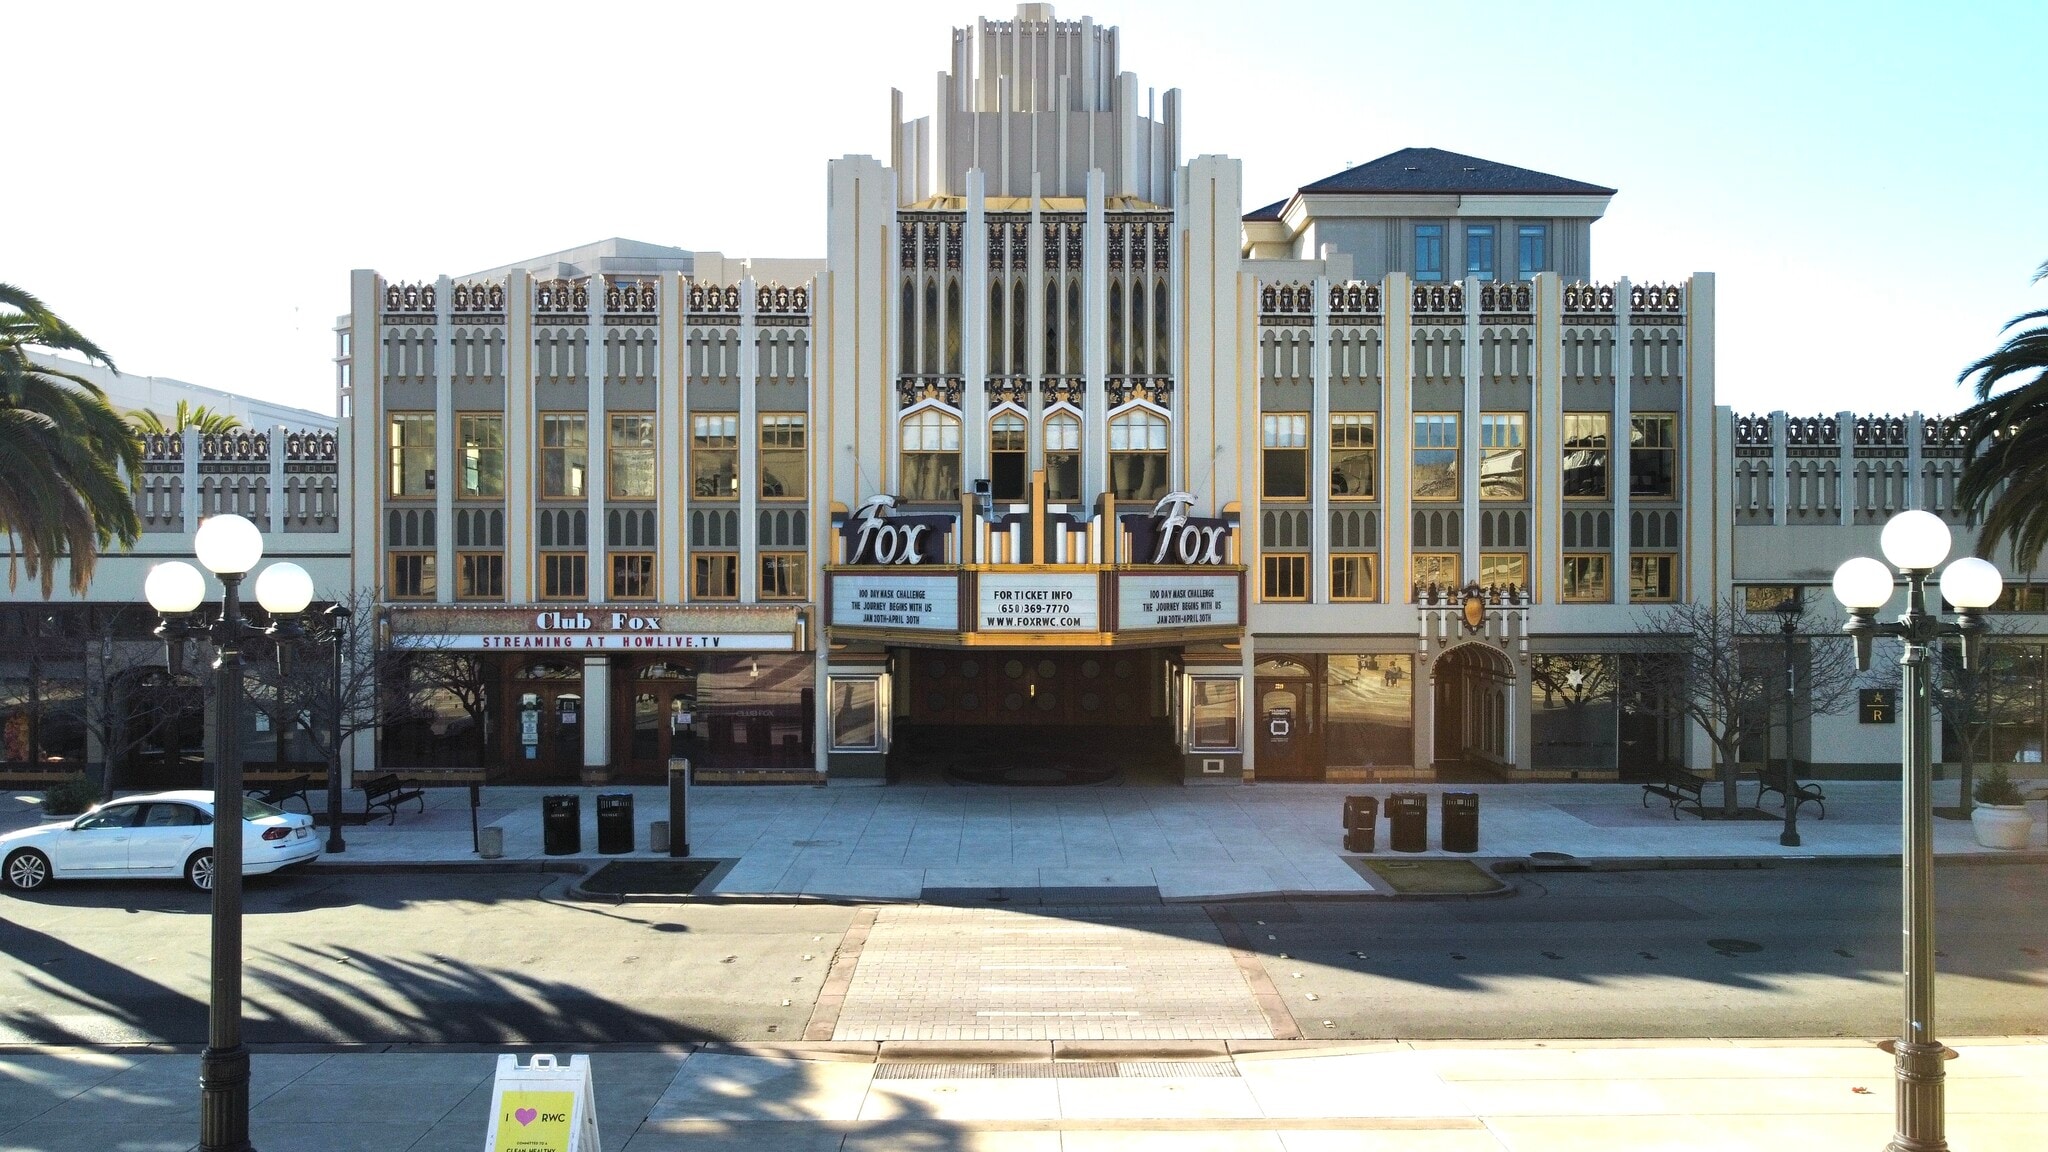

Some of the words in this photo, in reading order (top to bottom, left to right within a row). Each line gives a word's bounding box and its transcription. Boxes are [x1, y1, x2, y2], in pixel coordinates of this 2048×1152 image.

[859, 590, 868, 598] 100
[870, 590, 879, 598] DAY
[880, 590, 894, 598] MASK
[896, 590, 925, 599] CHALLENGE
[994, 591, 1012, 599] FOR
[1014, 591, 1048, 599] TICKET
[1051, 591, 1073, 599] INFO
[1150, 590, 1160, 598] 100
[1161, 590, 1172, 598] DAY
[1172, 590, 1187, 598] MASK
[1187, 589, 1214, 598] CHALLENGE
[852, 602, 860, 610] THE
[863, 602, 886, 610] JOURNEY
[889, 602, 907, 611] BEGINS
[909, 603, 922, 612] WITH
[924, 604, 932, 612] US
[1142, 603, 1153, 611] THE
[1156, 602, 1179, 611] JOURNEY
[1182, 602, 1199, 610] BEGINS
[1201, 602, 1212, 610] WITH
[1214, 601, 1221, 610] US
[536, 612, 592, 630] Club
[611, 612, 661, 630] Fox
[863, 614, 873, 622] JAN
[906, 615, 919, 624] 30TH
[987, 617, 1080, 626] WWW.FOXRWC.COM
[1157, 615, 1167, 624] JAN
[1199, 613, 1212, 622] 30TH
[482, 637, 572, 647] STREAMING
[585, 637, 605, 647] AT
[623, 637, 720, 647] HOWLIVE.TV
[1873, 709, 1882, 721] R
[505, 1113, 509, 1122] I
[541, 1113, 566, 1122] RWC
